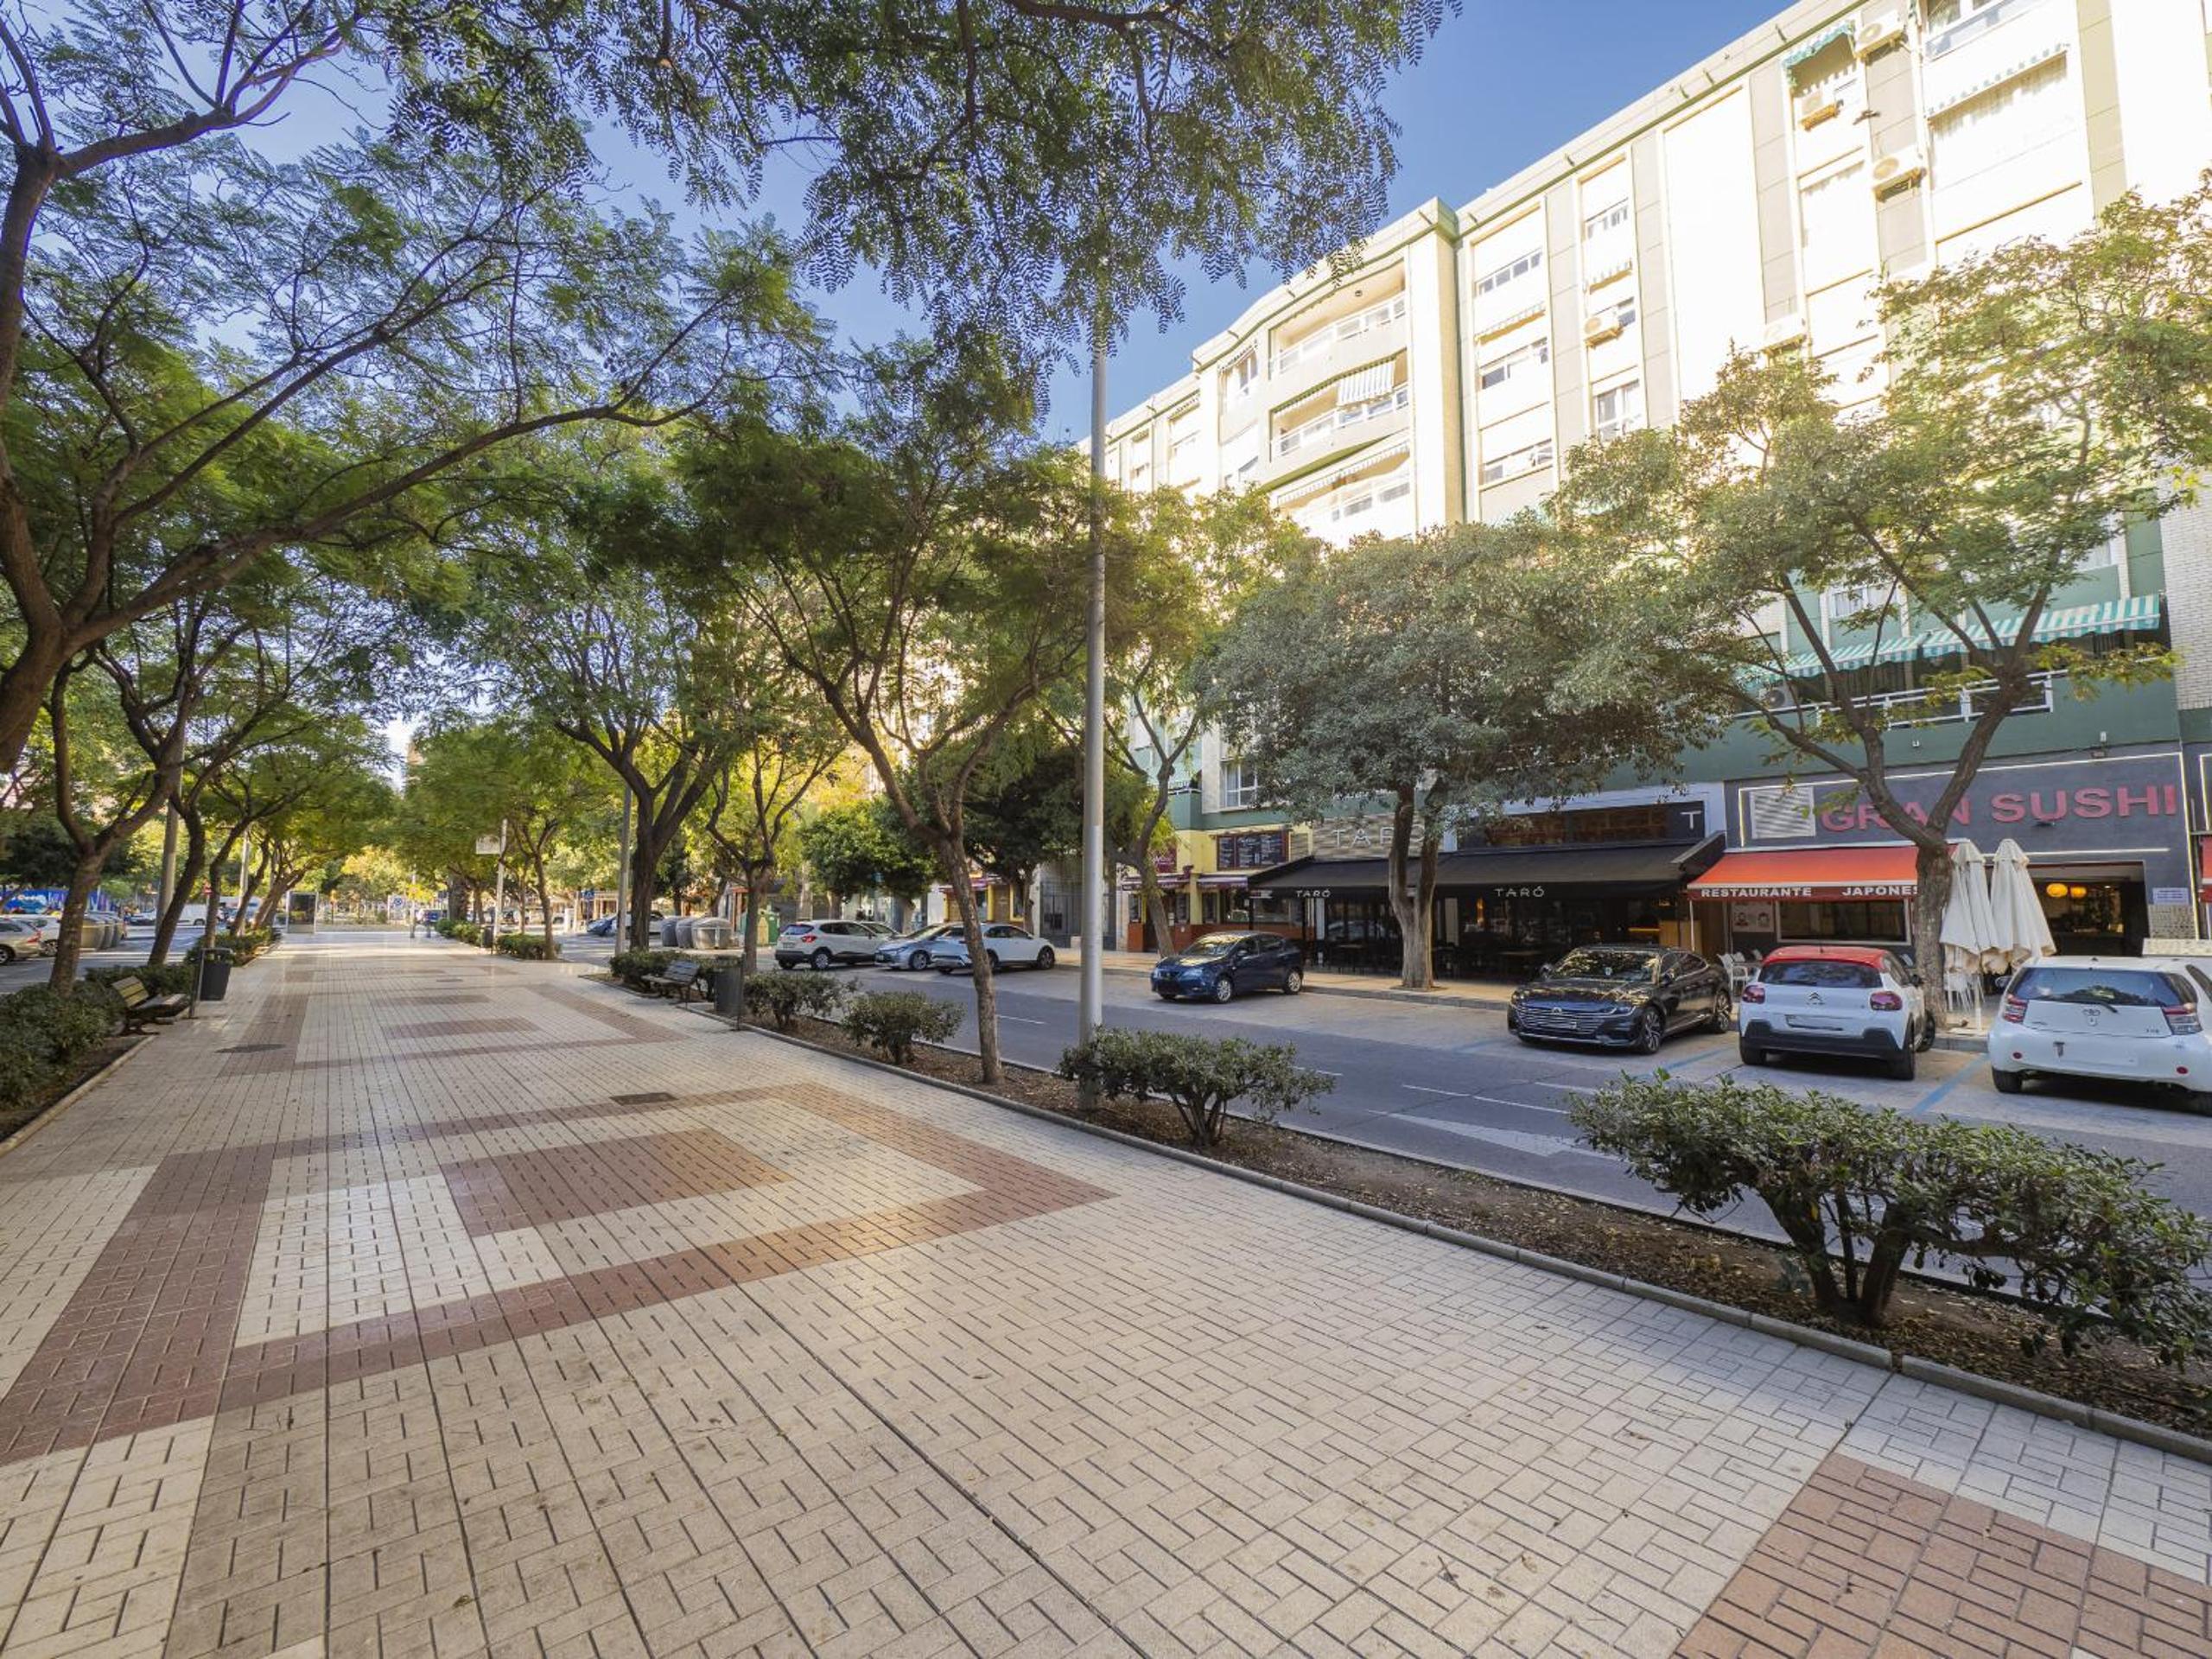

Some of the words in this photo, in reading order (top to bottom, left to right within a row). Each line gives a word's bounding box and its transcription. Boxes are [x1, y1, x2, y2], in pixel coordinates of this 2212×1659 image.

[1991, 784, 2177, 823] SUSHI
[1493, 885, 1545, 898] TARÓ
[1701, 887, 1812, 898] RESTAURANTE
